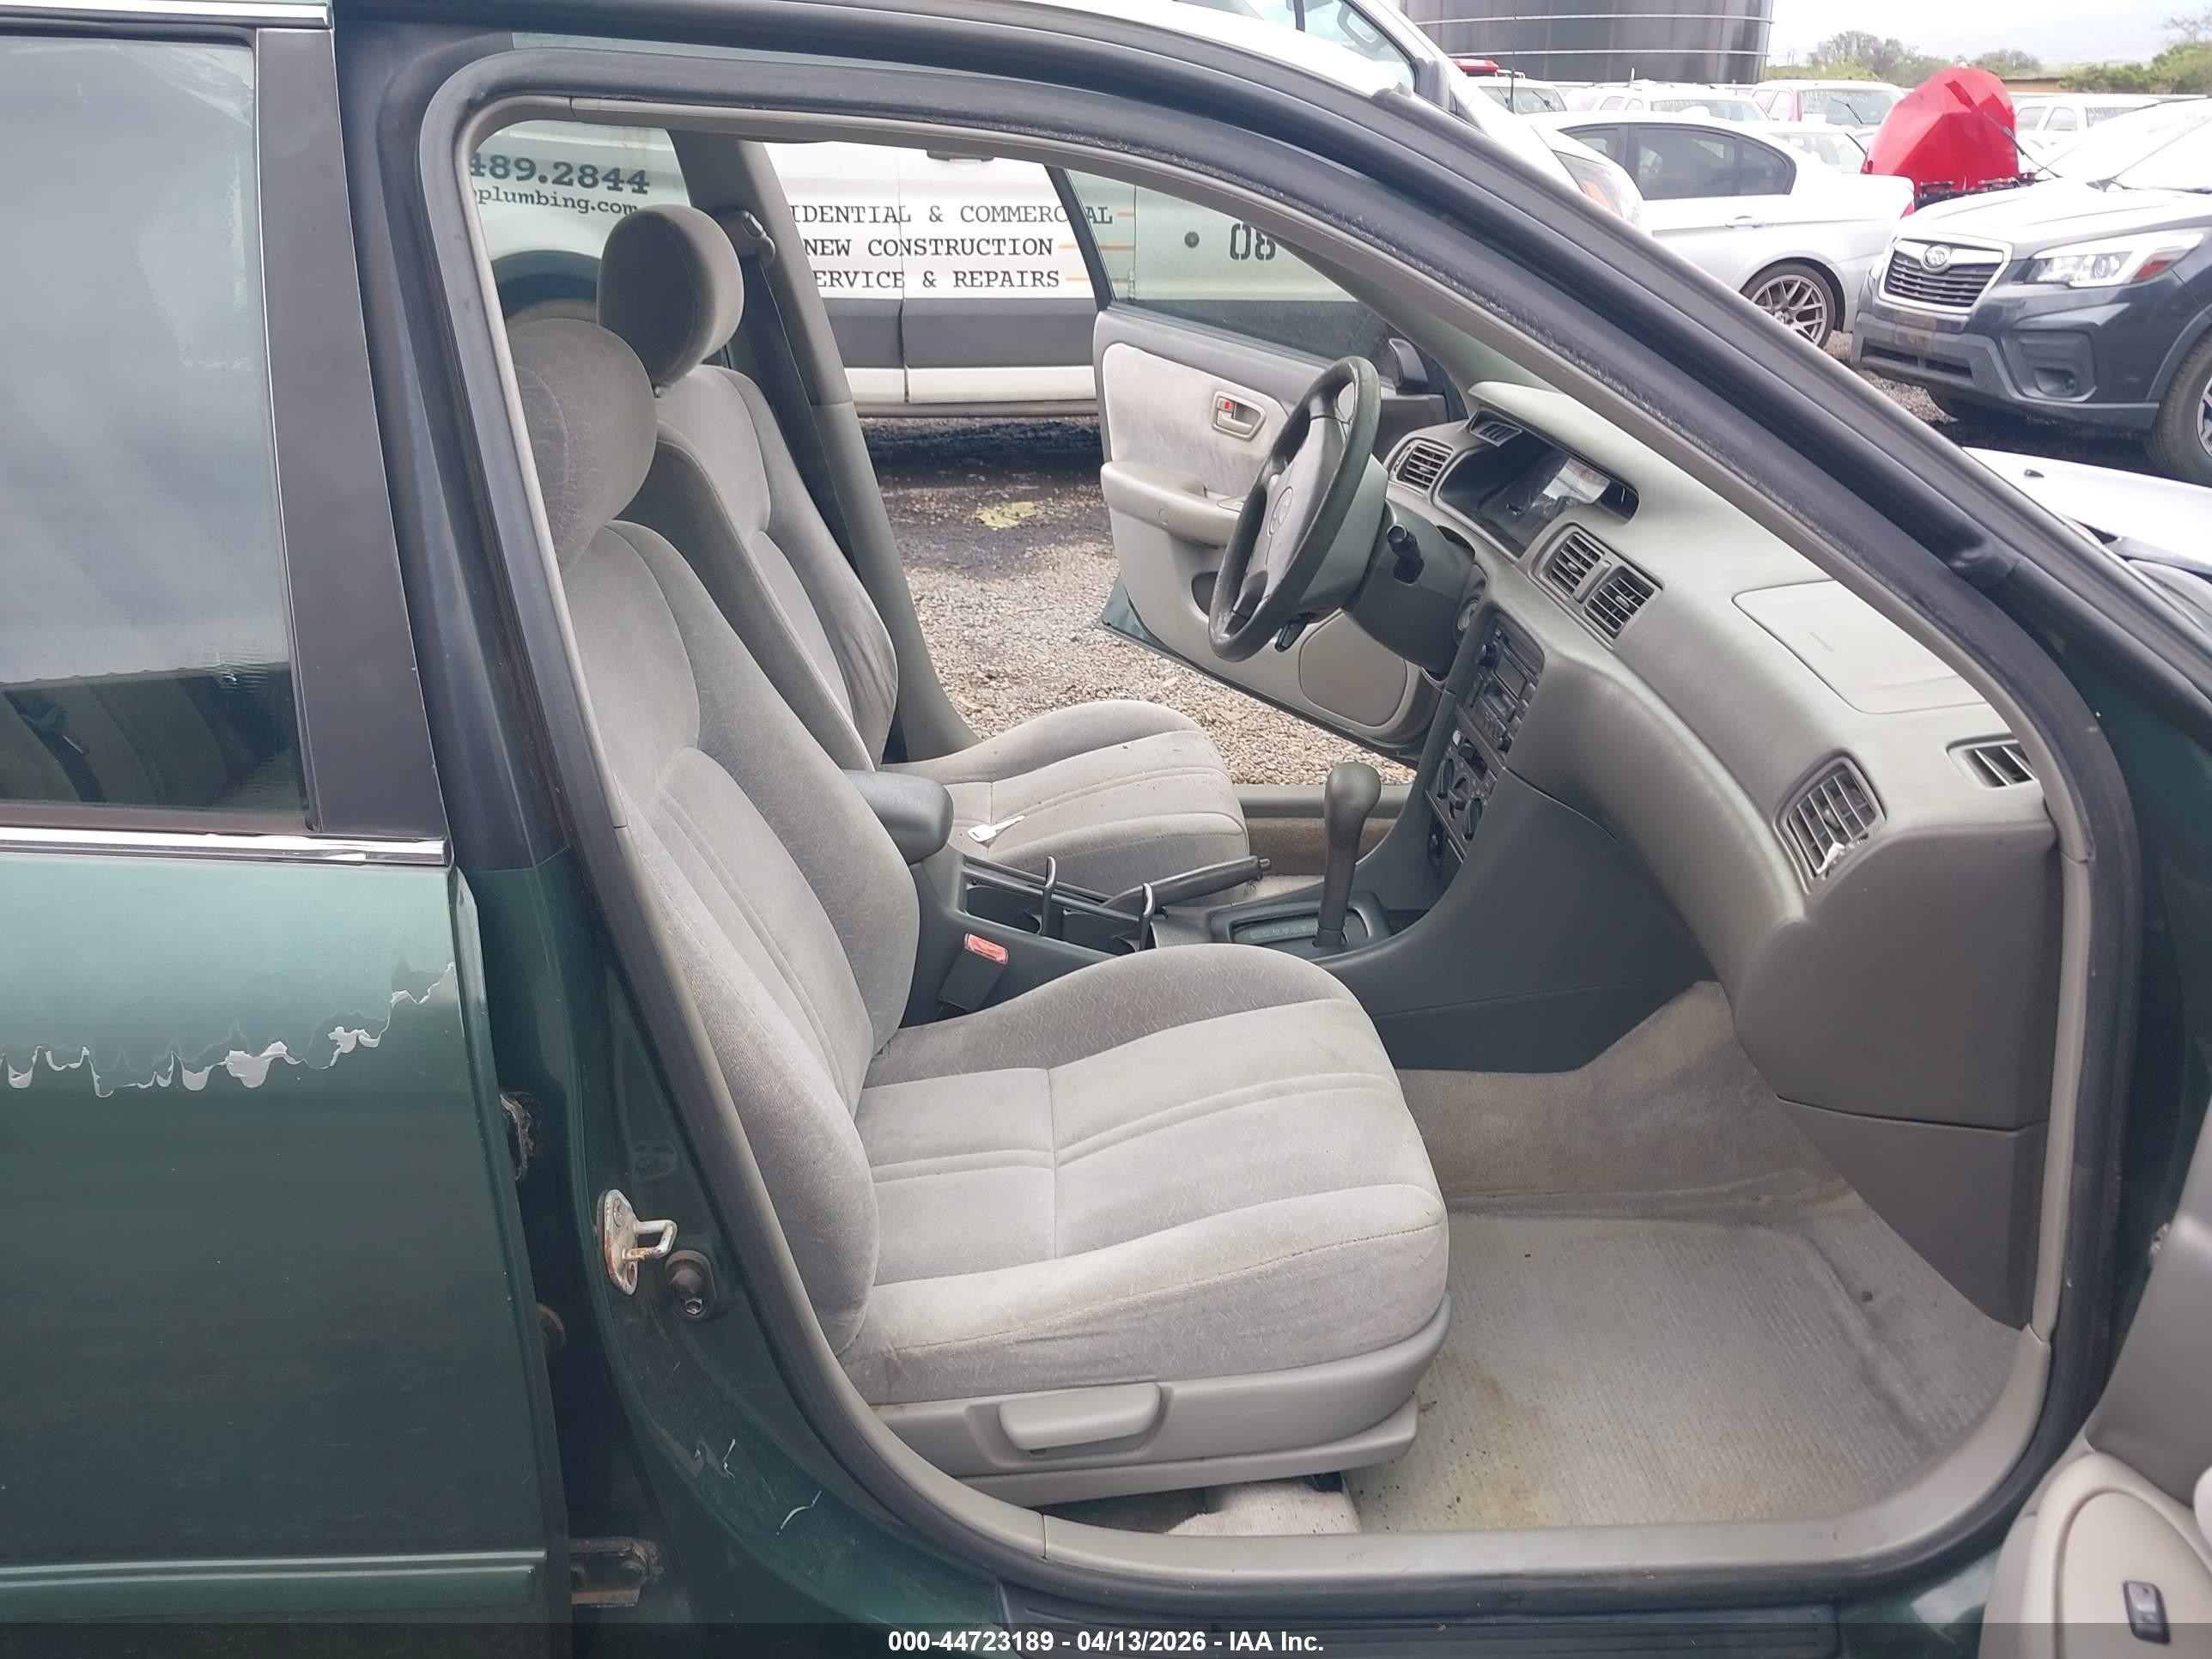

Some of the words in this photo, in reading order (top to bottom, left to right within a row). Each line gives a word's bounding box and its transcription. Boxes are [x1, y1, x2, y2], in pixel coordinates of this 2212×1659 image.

[470, 152, 650, 195] 489.2844
[473, 186, 638, 215] plumbing.com
[790, 204, 912, 223] IDENTIAL
[929, 205, 944, 222] &
[960, 205, 1113, 224] COMMERCAL
[804, 239, 852, 256] NEW
[867, 239, 1054, 256] CONSTRUCTION
[812, 270, 905, 288] ERVICE
[922, 270, 937, 288] &
[952, 270, 1060, 288] REPAIRS
